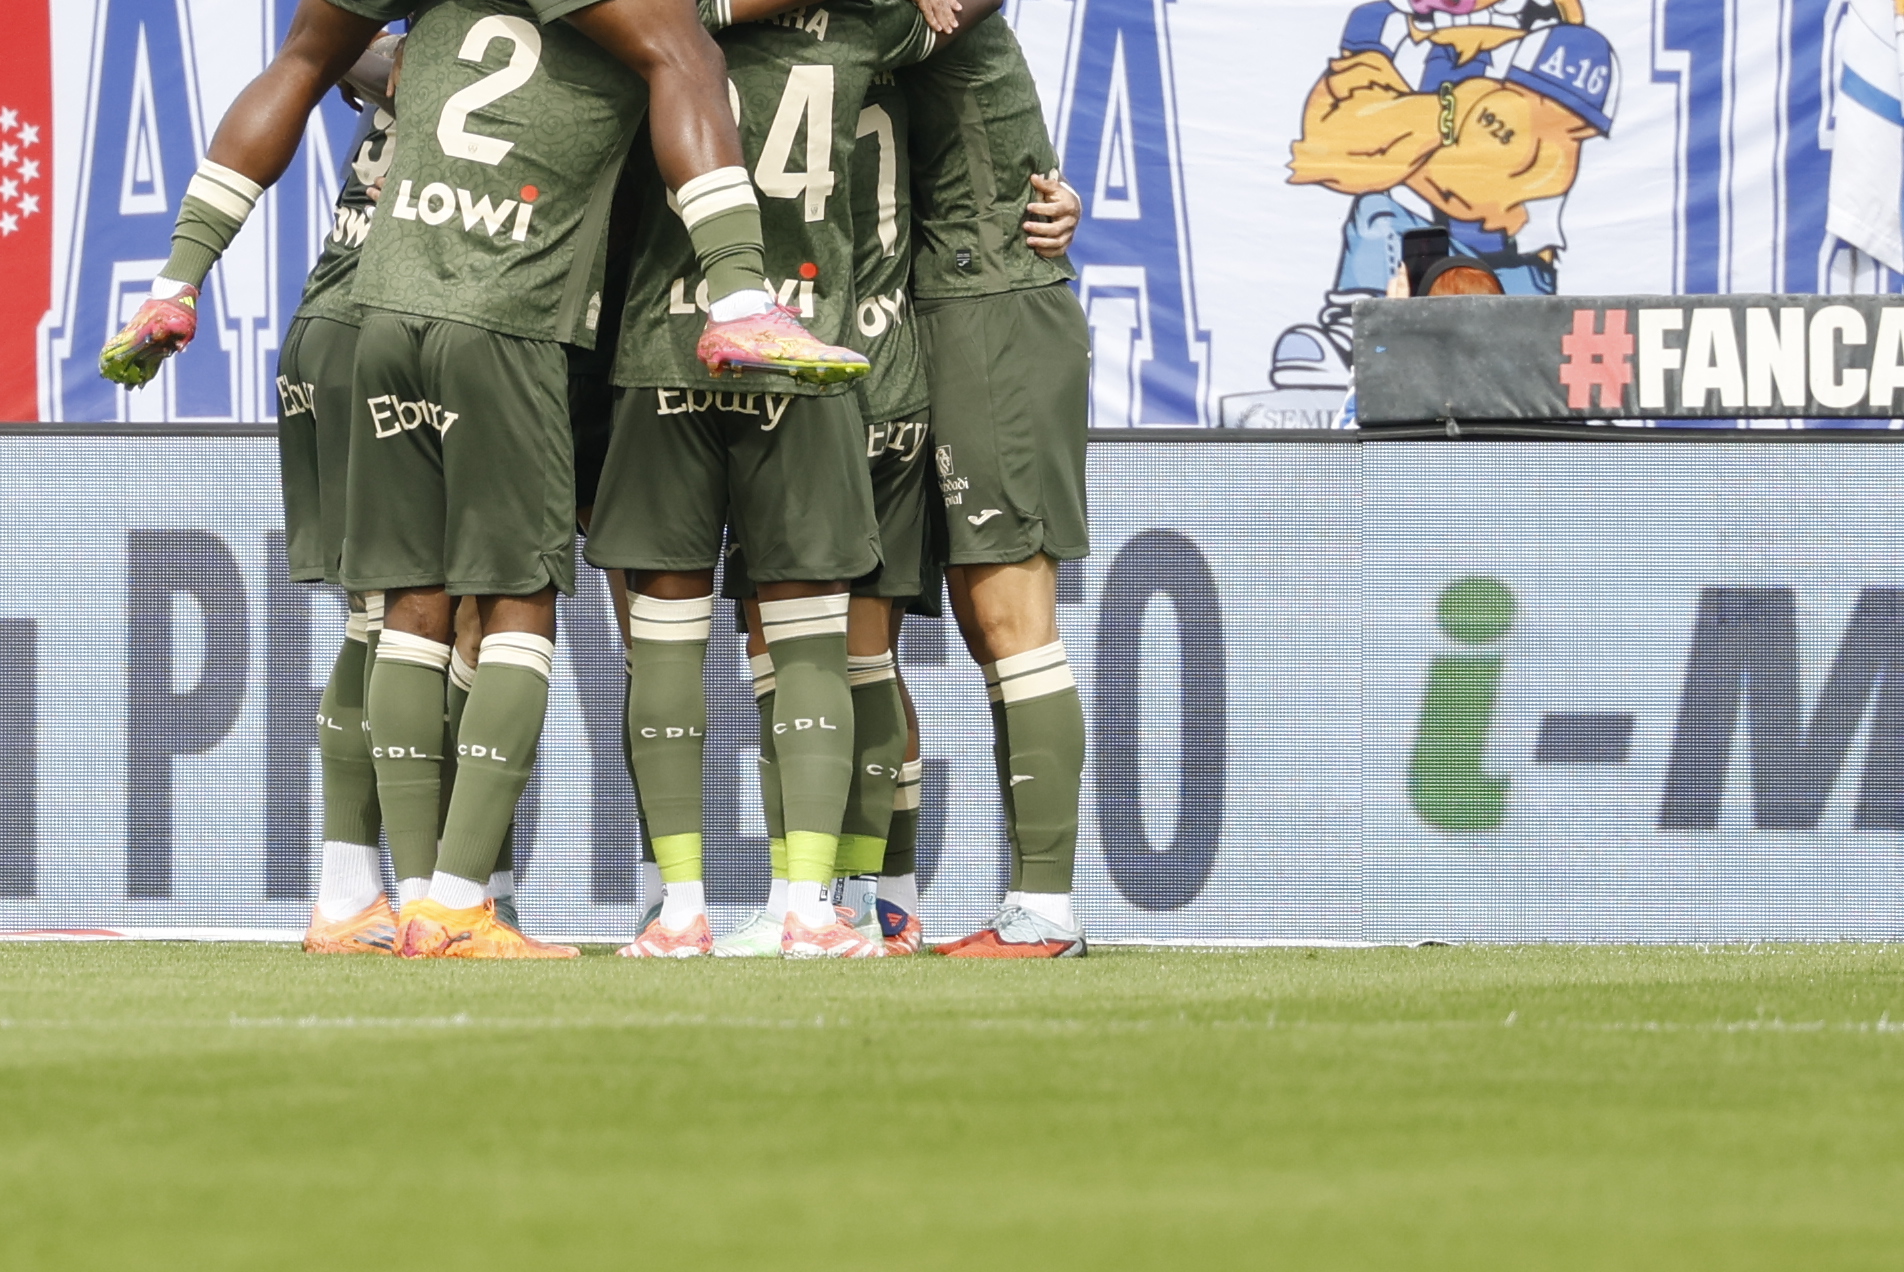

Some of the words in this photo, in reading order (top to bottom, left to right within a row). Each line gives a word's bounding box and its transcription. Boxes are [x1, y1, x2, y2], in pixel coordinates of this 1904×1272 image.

[436, 13, 543, 167] 2
[1538, 45, 1609, 95] A-16
[1477, 107, 1515, 145] 1928
